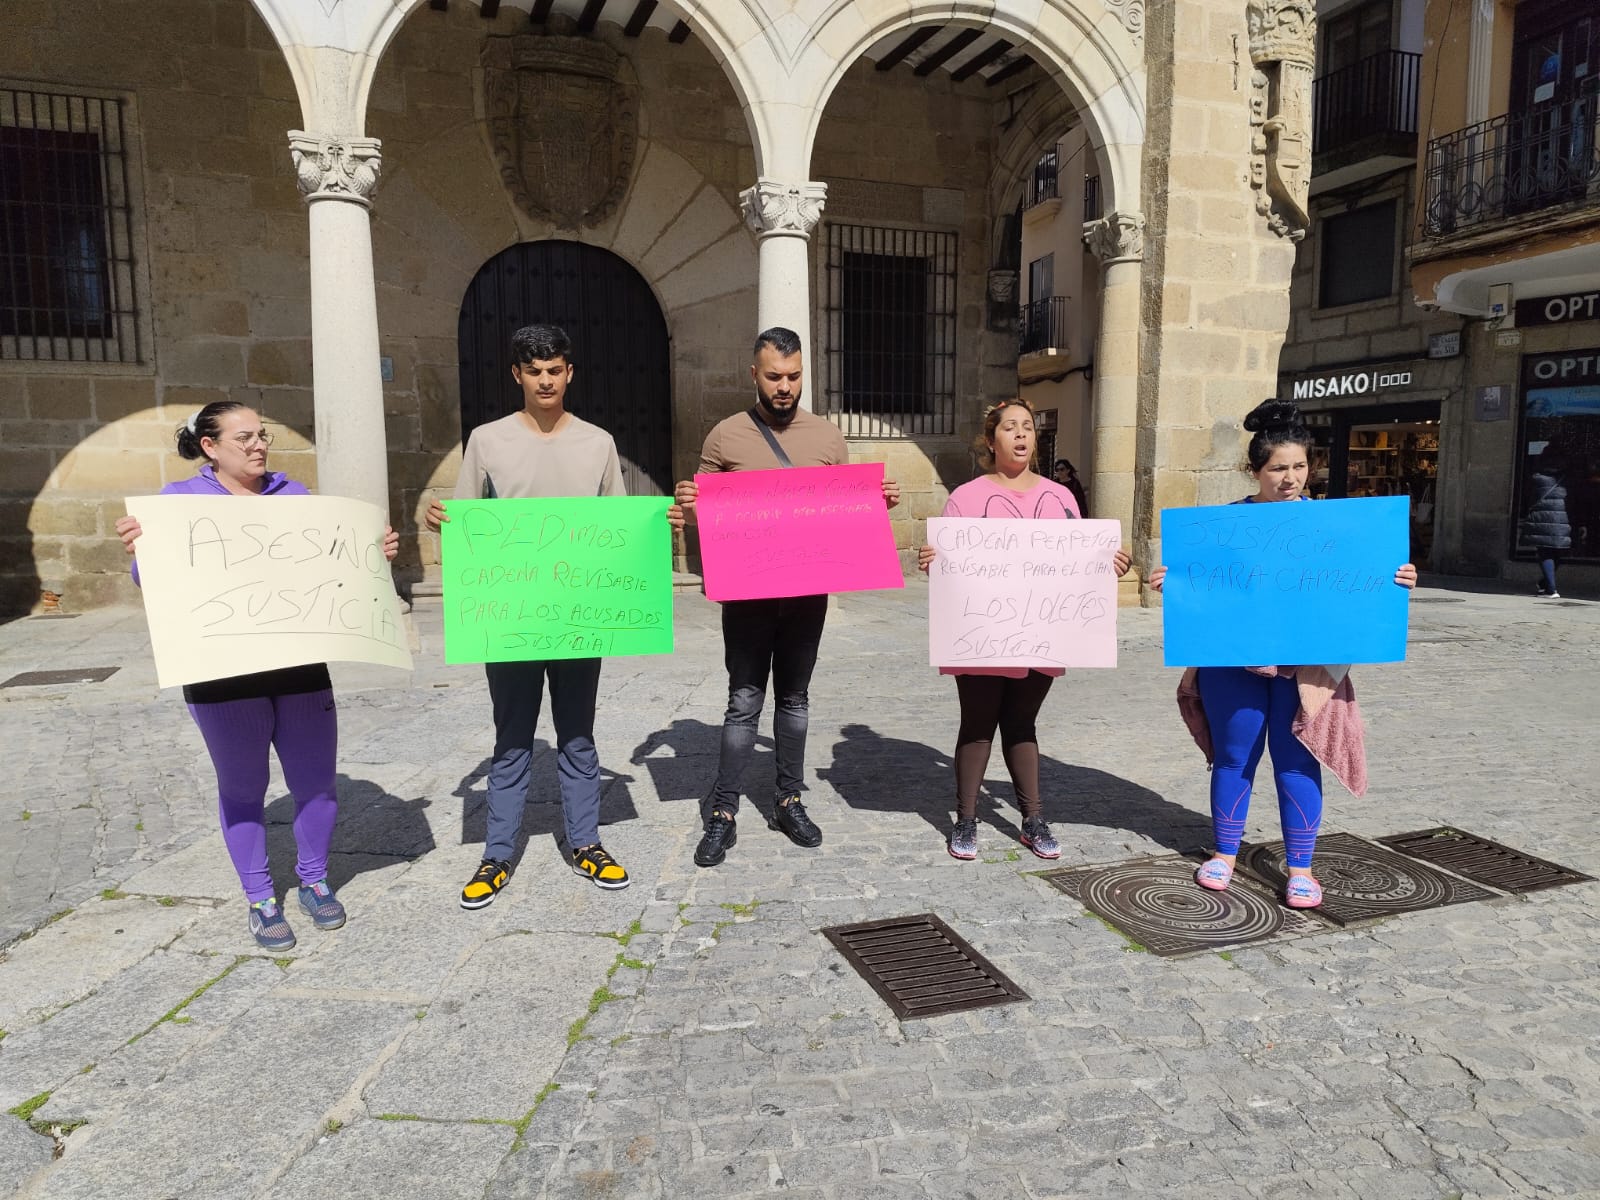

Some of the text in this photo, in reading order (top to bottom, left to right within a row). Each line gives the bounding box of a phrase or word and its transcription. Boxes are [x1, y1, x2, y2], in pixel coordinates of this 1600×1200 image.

[1545, 294, 1599, 321] OPT
[1293, 373, 1369, 399] MISAKO
[937, 526, 1119, 554] CADENA PERPETUA
[461, 562, 539, 588] CADENA
[1023, 563, 1056, 578] PARA
[1061, 561, 1080, 576] EL
[1187, 561, 1385, 593] PARA CAMELIA
[460, 597, 663, 625] PARA LOS ACUSADOS
[964, 596, 1017, 624] LOS
